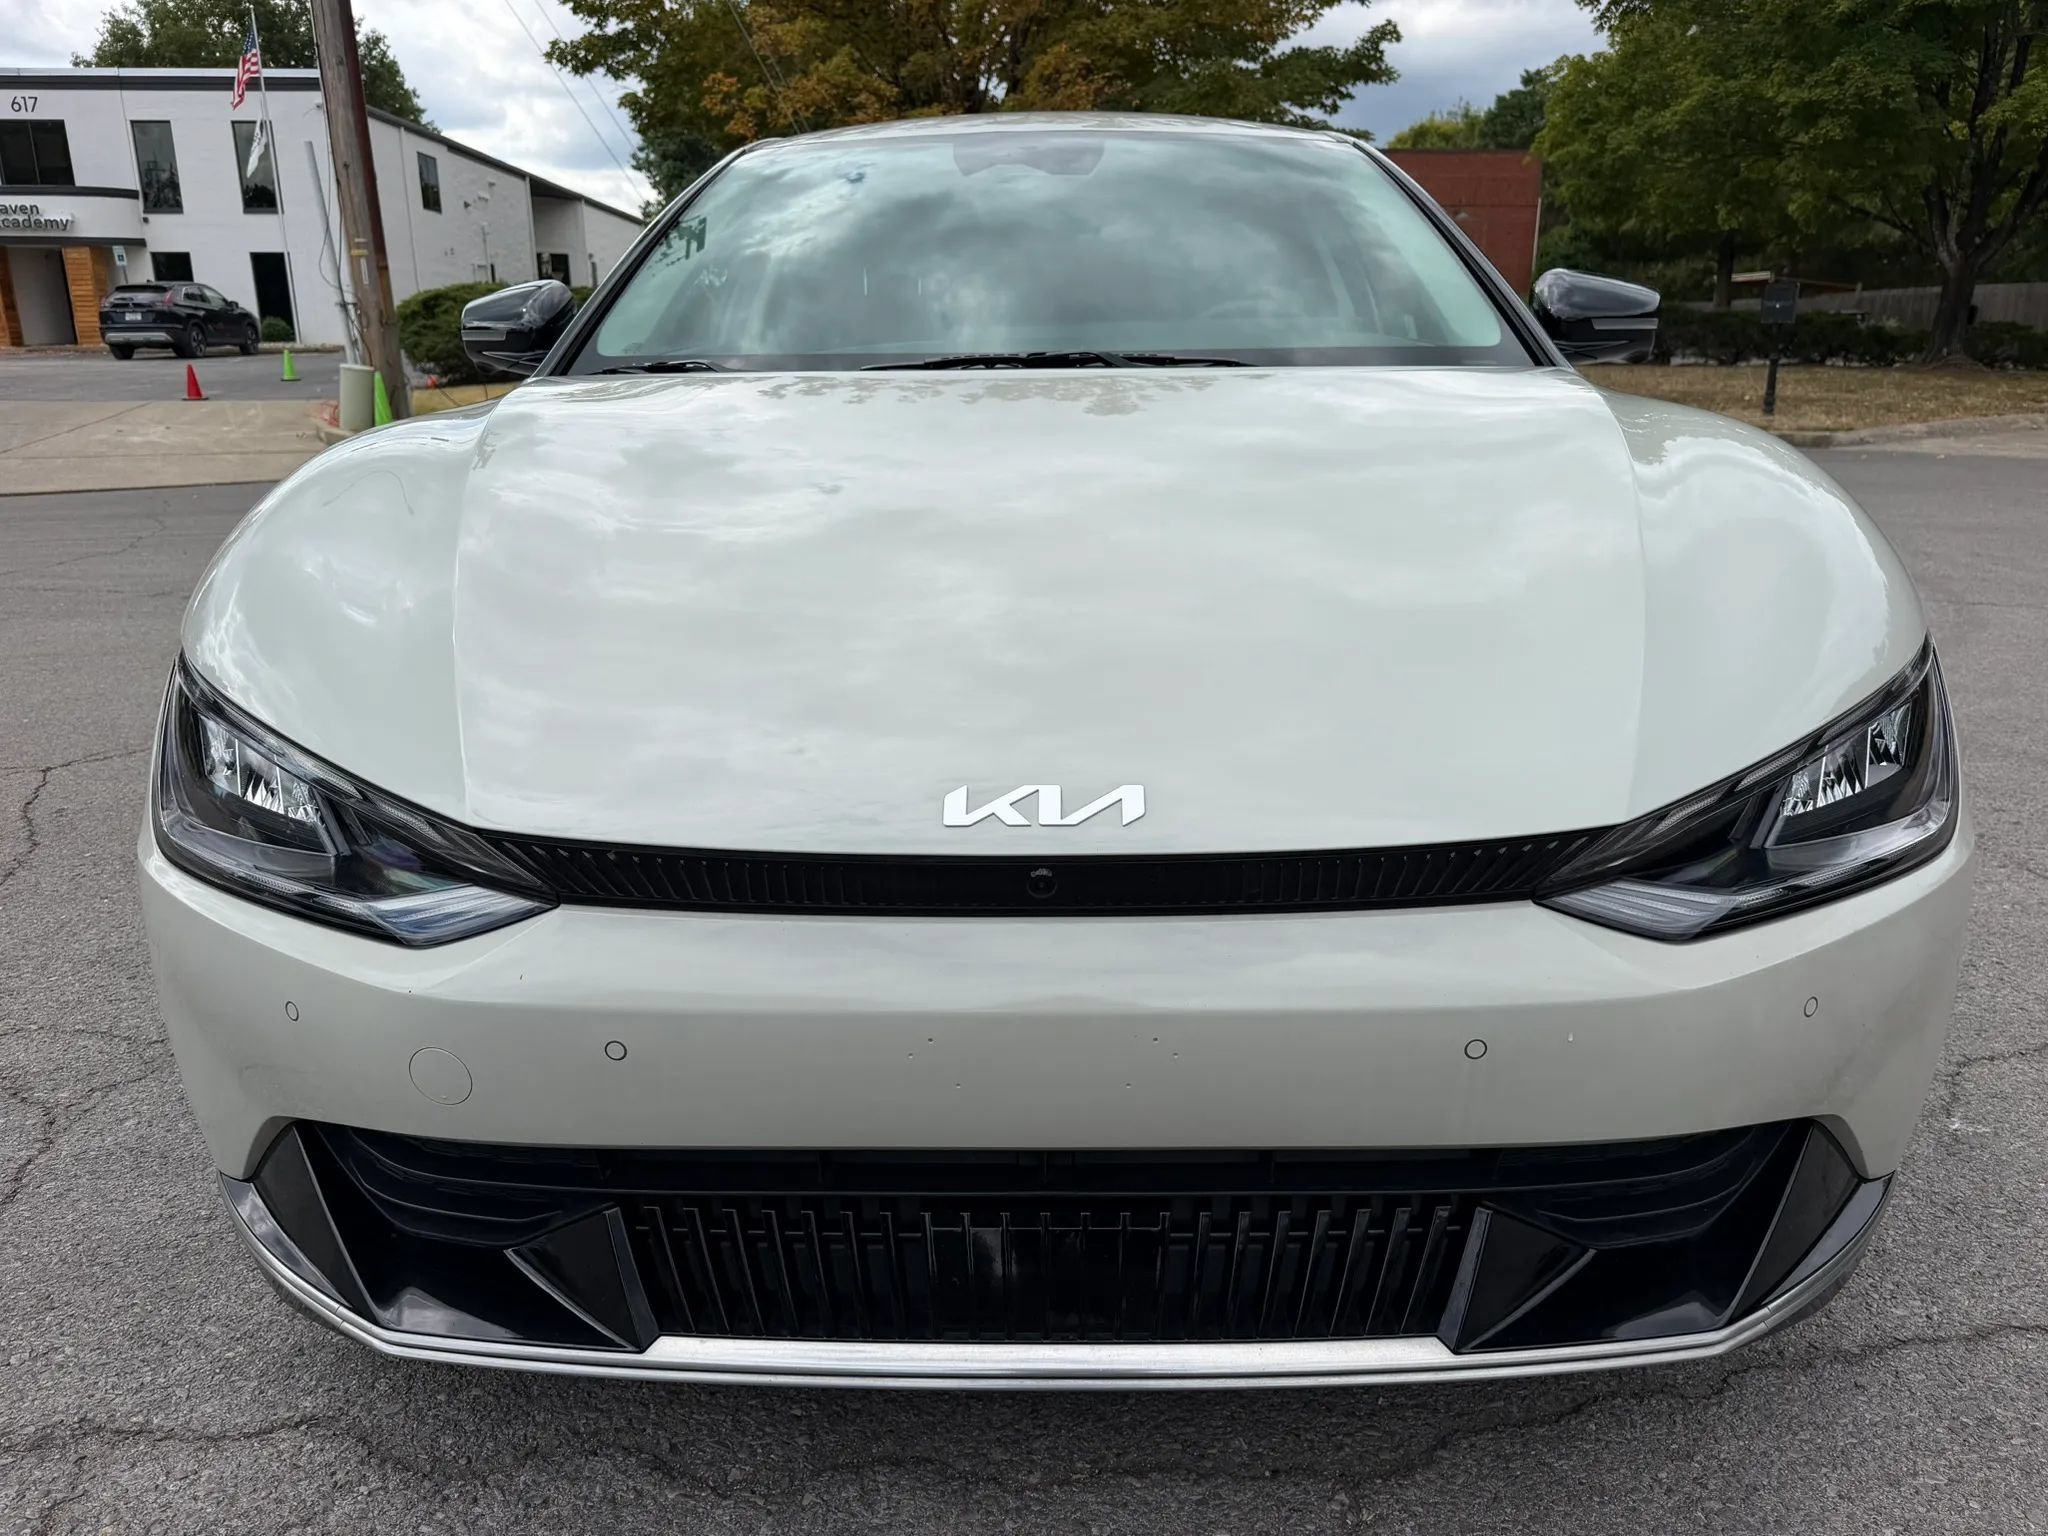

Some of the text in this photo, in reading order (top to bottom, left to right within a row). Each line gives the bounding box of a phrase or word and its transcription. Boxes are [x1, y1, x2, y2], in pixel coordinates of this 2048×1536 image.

[11, 96, 38, 113] 617
[0, 204, 40, 215] aven
[0, 214, 69, 231] cademy
